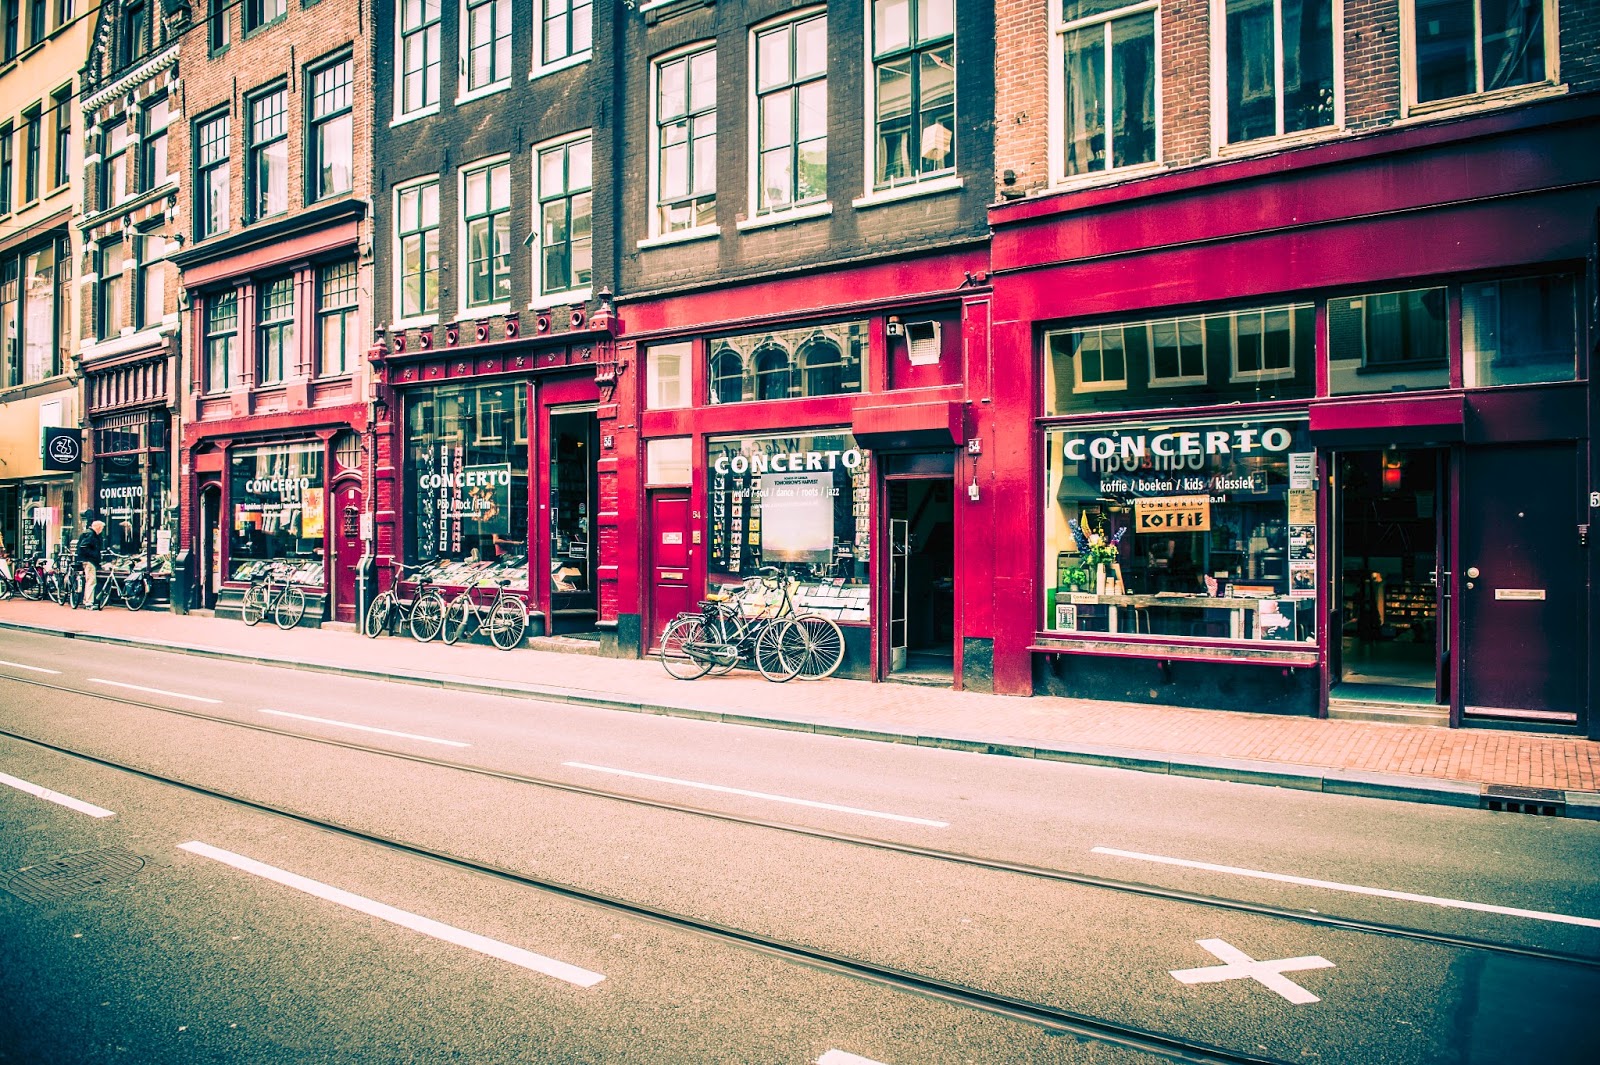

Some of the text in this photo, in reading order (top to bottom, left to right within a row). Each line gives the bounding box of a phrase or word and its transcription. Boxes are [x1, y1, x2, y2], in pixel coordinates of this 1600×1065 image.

[968, 440, 981, 453] 54
[1063, 427, 1292, 460] CONCERTO
[714, 449, 862, 474] CONCERTO
[245, 477, 309, 493] CONCERTO
[419, 470, 510, 489] CONCERTO
[1100, 480, 1128, 492] koffie
[1138, 479, 1172, 491] boeken
[1184, 477, 1204, 491] kids
[1215, 475, 1255, 489] klassiek
[99, 485, 143, 499] CONCERTO
[776, 487, 794, 497] dance
[801, 487, 819, 497] roots
[826, 486, 840, 499] jazz
[455, 497, 471, 510] Rock
[476, 498, 491, 510] Film
[692, 510, 701, 519] 54
